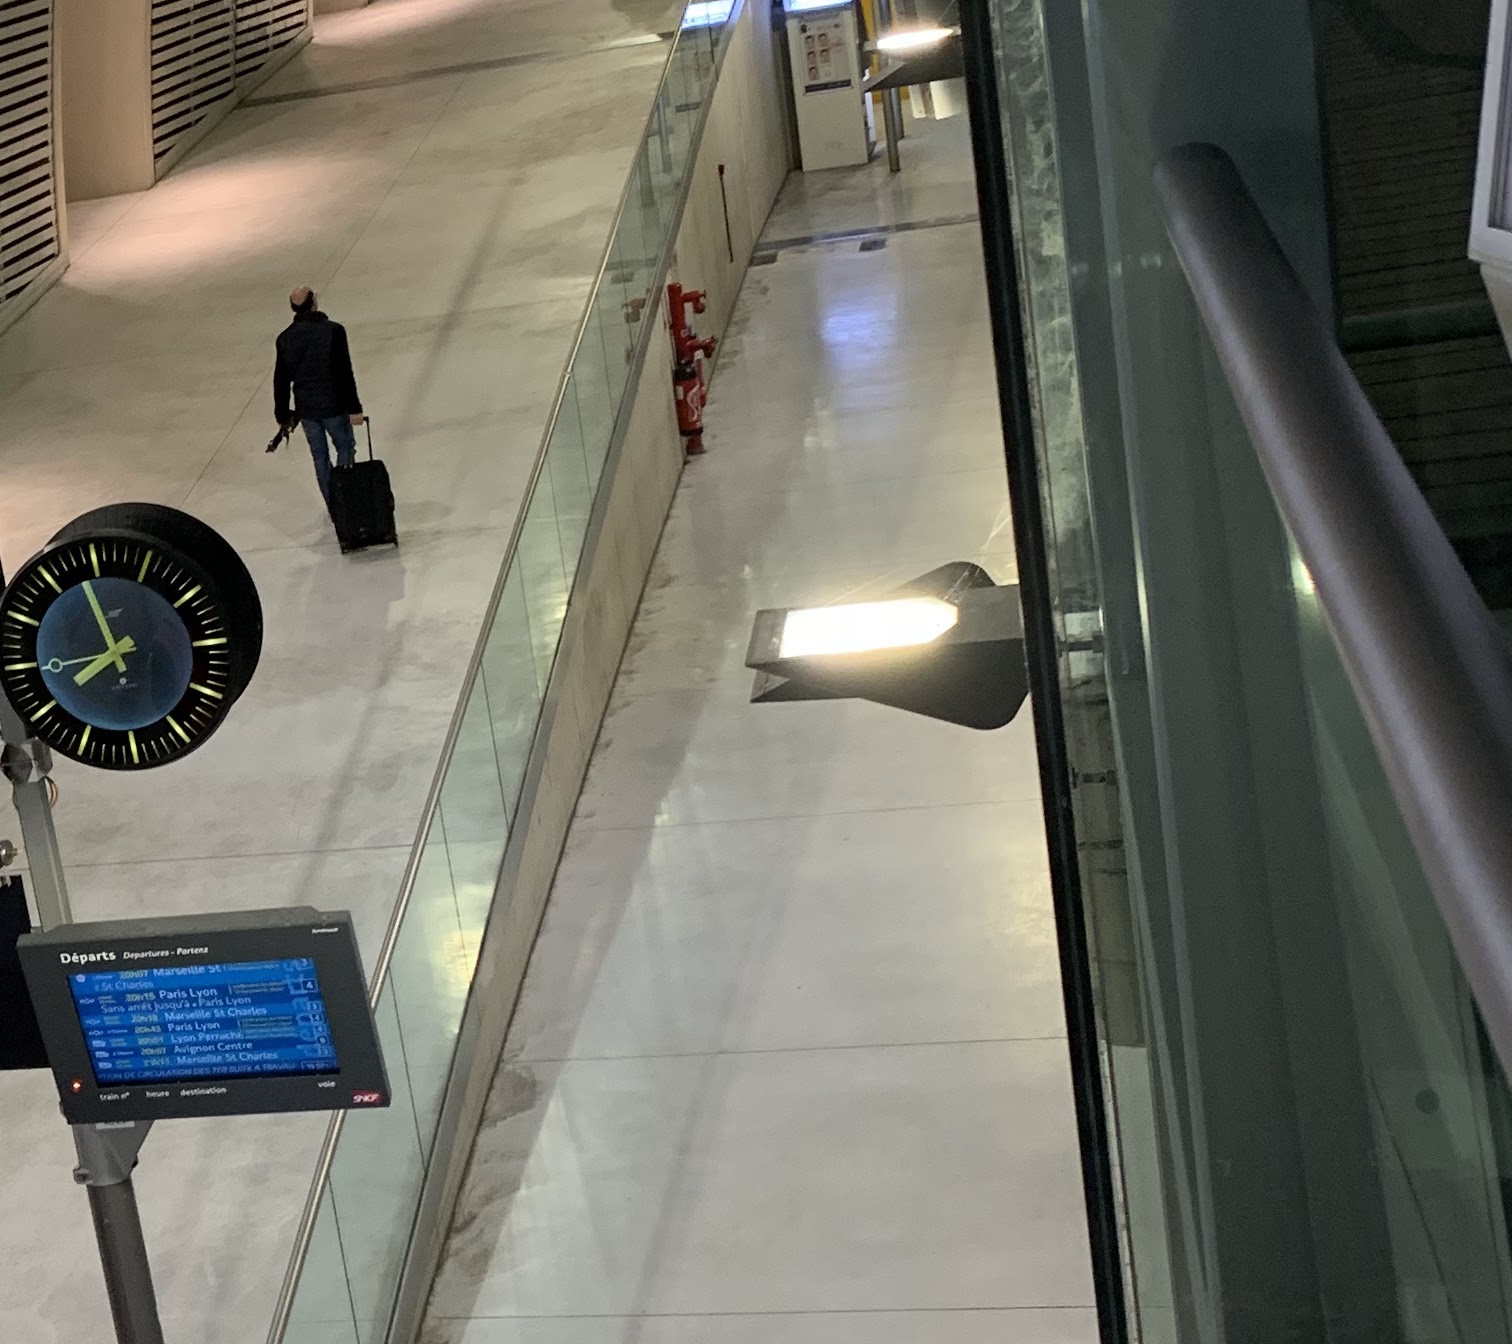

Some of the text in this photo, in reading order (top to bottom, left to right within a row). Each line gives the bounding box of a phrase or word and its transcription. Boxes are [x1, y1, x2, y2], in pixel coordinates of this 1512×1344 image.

[59, 950, 116, 965] Départs
[123, 950, 169, 960] Departures
[153, 965, 205, 976] Marseille
[159, 989, 187, 999] Paris
[189, 988, 218, 998] Lyon
[198, 998, 224, 1007] Paris
[225, 997, 251, 1006] Lyon
[227, 1007, 267, 1017] Charles
[167, 1022, 193, 1032] Paris
[194, 1021, 220, 1031] Lyon
[170, 1034, 196, 1044] Lyon
[174, 1043, 216, 1055] Avignon
[216, 1042, 253, 1052] Centre
[317, 1080, 335, 1088] voie
[145, 1090, 170, 1098] heure
[180, 1086, 227, 1096] destination
[99, 1093, 119, 1101] train
